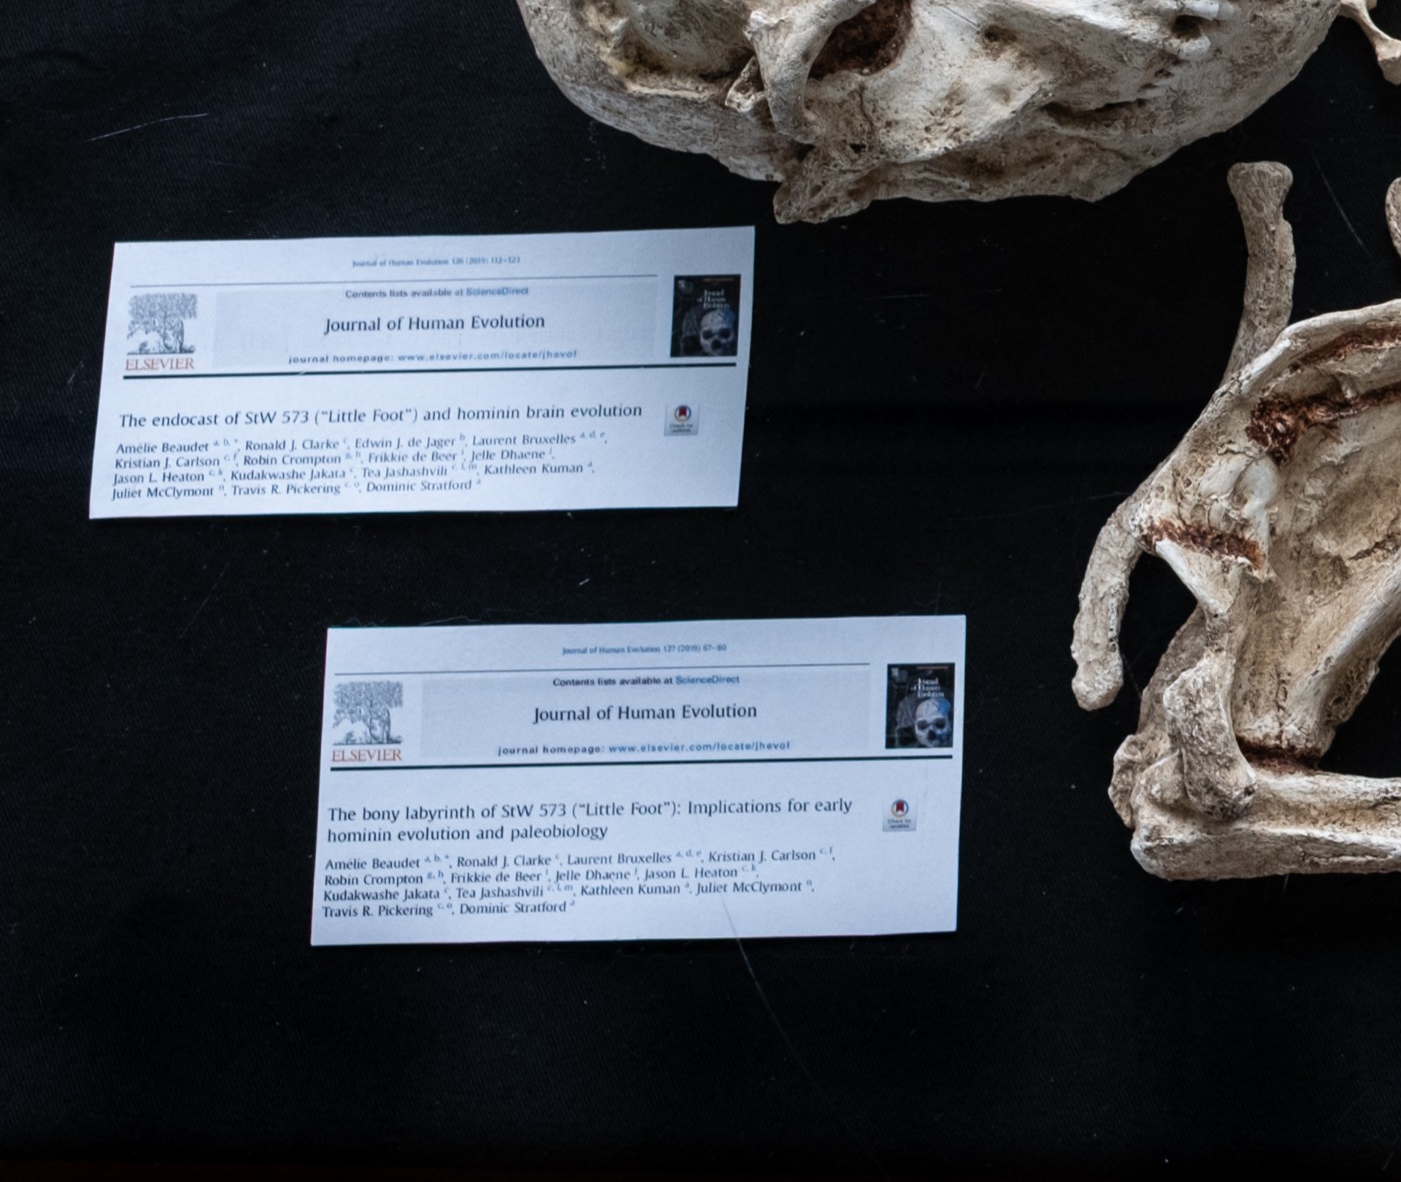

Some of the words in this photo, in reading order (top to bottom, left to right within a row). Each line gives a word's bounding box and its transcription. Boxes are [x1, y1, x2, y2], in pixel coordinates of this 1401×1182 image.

[326, 317, 380, 337] Journal
[387, 316, 404, 331] of
[409, 316, 464, 330] Human
[471, 315, 544, 329] Evolution
[125, 358, 194, 371] ELSEVIER
[120, 414, 146, 428] The
[152, 413, 218, 427] endocast
[225, 412, 238, 425] of
[245, 412, 276, 425] StW
[282, 411, 309, 424] 573
[315, 410, 366, 426] ("Little
[373, 409, 417, 424] Foot")
[423, 408, 450, 421] and
[457, 407, 519, 421] hominin
[527, 406, 564, 419] brain
[571, 405, 642, 418] evolution
[116, 443, 157, 454] Amélie
[162, 442, 208, 453] Beaudet
[246, 440, 286, 452] Ronald
[291, 439, 296, 453] J.
[302, 439, 339, 450] Clarke
[355, 438, 392, 449] Edwin
[397, 437, 402, 451] J.
[408, 437, 422, 448] de
[425, 436, 456, 450] Jager
[473, 435, 516, 447] Laurent
[522, 434, 576, 446] Bruxelles
[115, 457, 160, 468] Kristian
[165, 456, 171, 470] J.
[176, 456, 220, 467] Carlson
[244, 454, 277, 466] Robin
[282, 453, 341, 467] Crompton
[368, 451, 408, 463] Frikkie
[412, 451, 427, 462] de
[431, 450, 457, 462] Beer
[471, 449, 496, 463] Jelle
[501, 449, 545, 460] Dhaene
[553, 678, 595, 687] Contents
[597, 677, 616, 686] lists
[619, 676, 661, 686] available
[663, 676, 673, 685] at
[675, 675, 740, 685] ScienceDirect
[535, 707, 590, 726] Journal
[597, 706, 612, 720] of
[618, 706, 675, 720] Human
[682, 704, 757, 719] Evolution
[332, 749, 402, 762] ELSEVIER
[498, 745, 538, 756] journal
[543, 744, 604, 755] homepage:
[608, 742, 790, 753] www.elsevier.com/locate/jhevol
[329, 808, 356, 822] The
[363, 807, 400, 825] bony
[406, 806, 475, 824] labyrinth
[481, 805, 495, 819] of
[502, 804, 533, 818] StW
[539, 804, 566, 818] 573
[572, 803, 624, 819] ("Little
[631, 802, 680, 818] Foot"):
[689, 800, 781, 818] Implications
[788, 799, 809, 813] for
[815, 798, 852, 817] early
[328, 828, 391, 842] hominin
[398, 827, 470, 841] evolution
[476, 826, 504, 840] and
[511, 824, 608, 843] paleobiology
[325, 859, 367, 870] Amélie
[372, 858, 420, 869] Beaudet
[457, 856, 498, 868] Ronald
[503, 855, 509, 869] J.
[514, 855, 551, 867] Clarke
[568, 854, 612, 866] Laurent
[618, 853, 672, 865] Bruxelles
[709, 851, 755, 863] Kristian
[759, 850, 766, 864] J.
[771, 850, 816, 861] Carlson
[325, 875, 358, 886] Robin
[364, 874, 423, 887] Crompton
[451, 872, 491, 884] Frikkie
[495, 871, 510, 883] de
[515, 871, 542, 882] Beer
[556, 870, 581, 884] Jelle
[586, 869, 630, 881] Dhaene
[645, 868, 676, 882] Jason
[681, 867, 689, 879] L.
[695, 867, 737, 878] Heaton
[324, 890, 399, 902] Kudakwashe
[404, 889, 440, 903] Jakata
[456, 888, 476, 899] Tea
[480, 887, 543, 901] Jashashvili
[581, 885, 633, 897] Kathleen
[638, 884, 680, 896] Kuman
[696, 883, 727, 897] Juliet
[733, 882, 802, 896] McClymont
[322, 906, 358, 918] Travis
[363, 905, 373, 917] R.
[378, 905, 433, 918] Pickering
[460, 903, 509, 915] Dominic
[515, 902, 566, 913] Stratford
